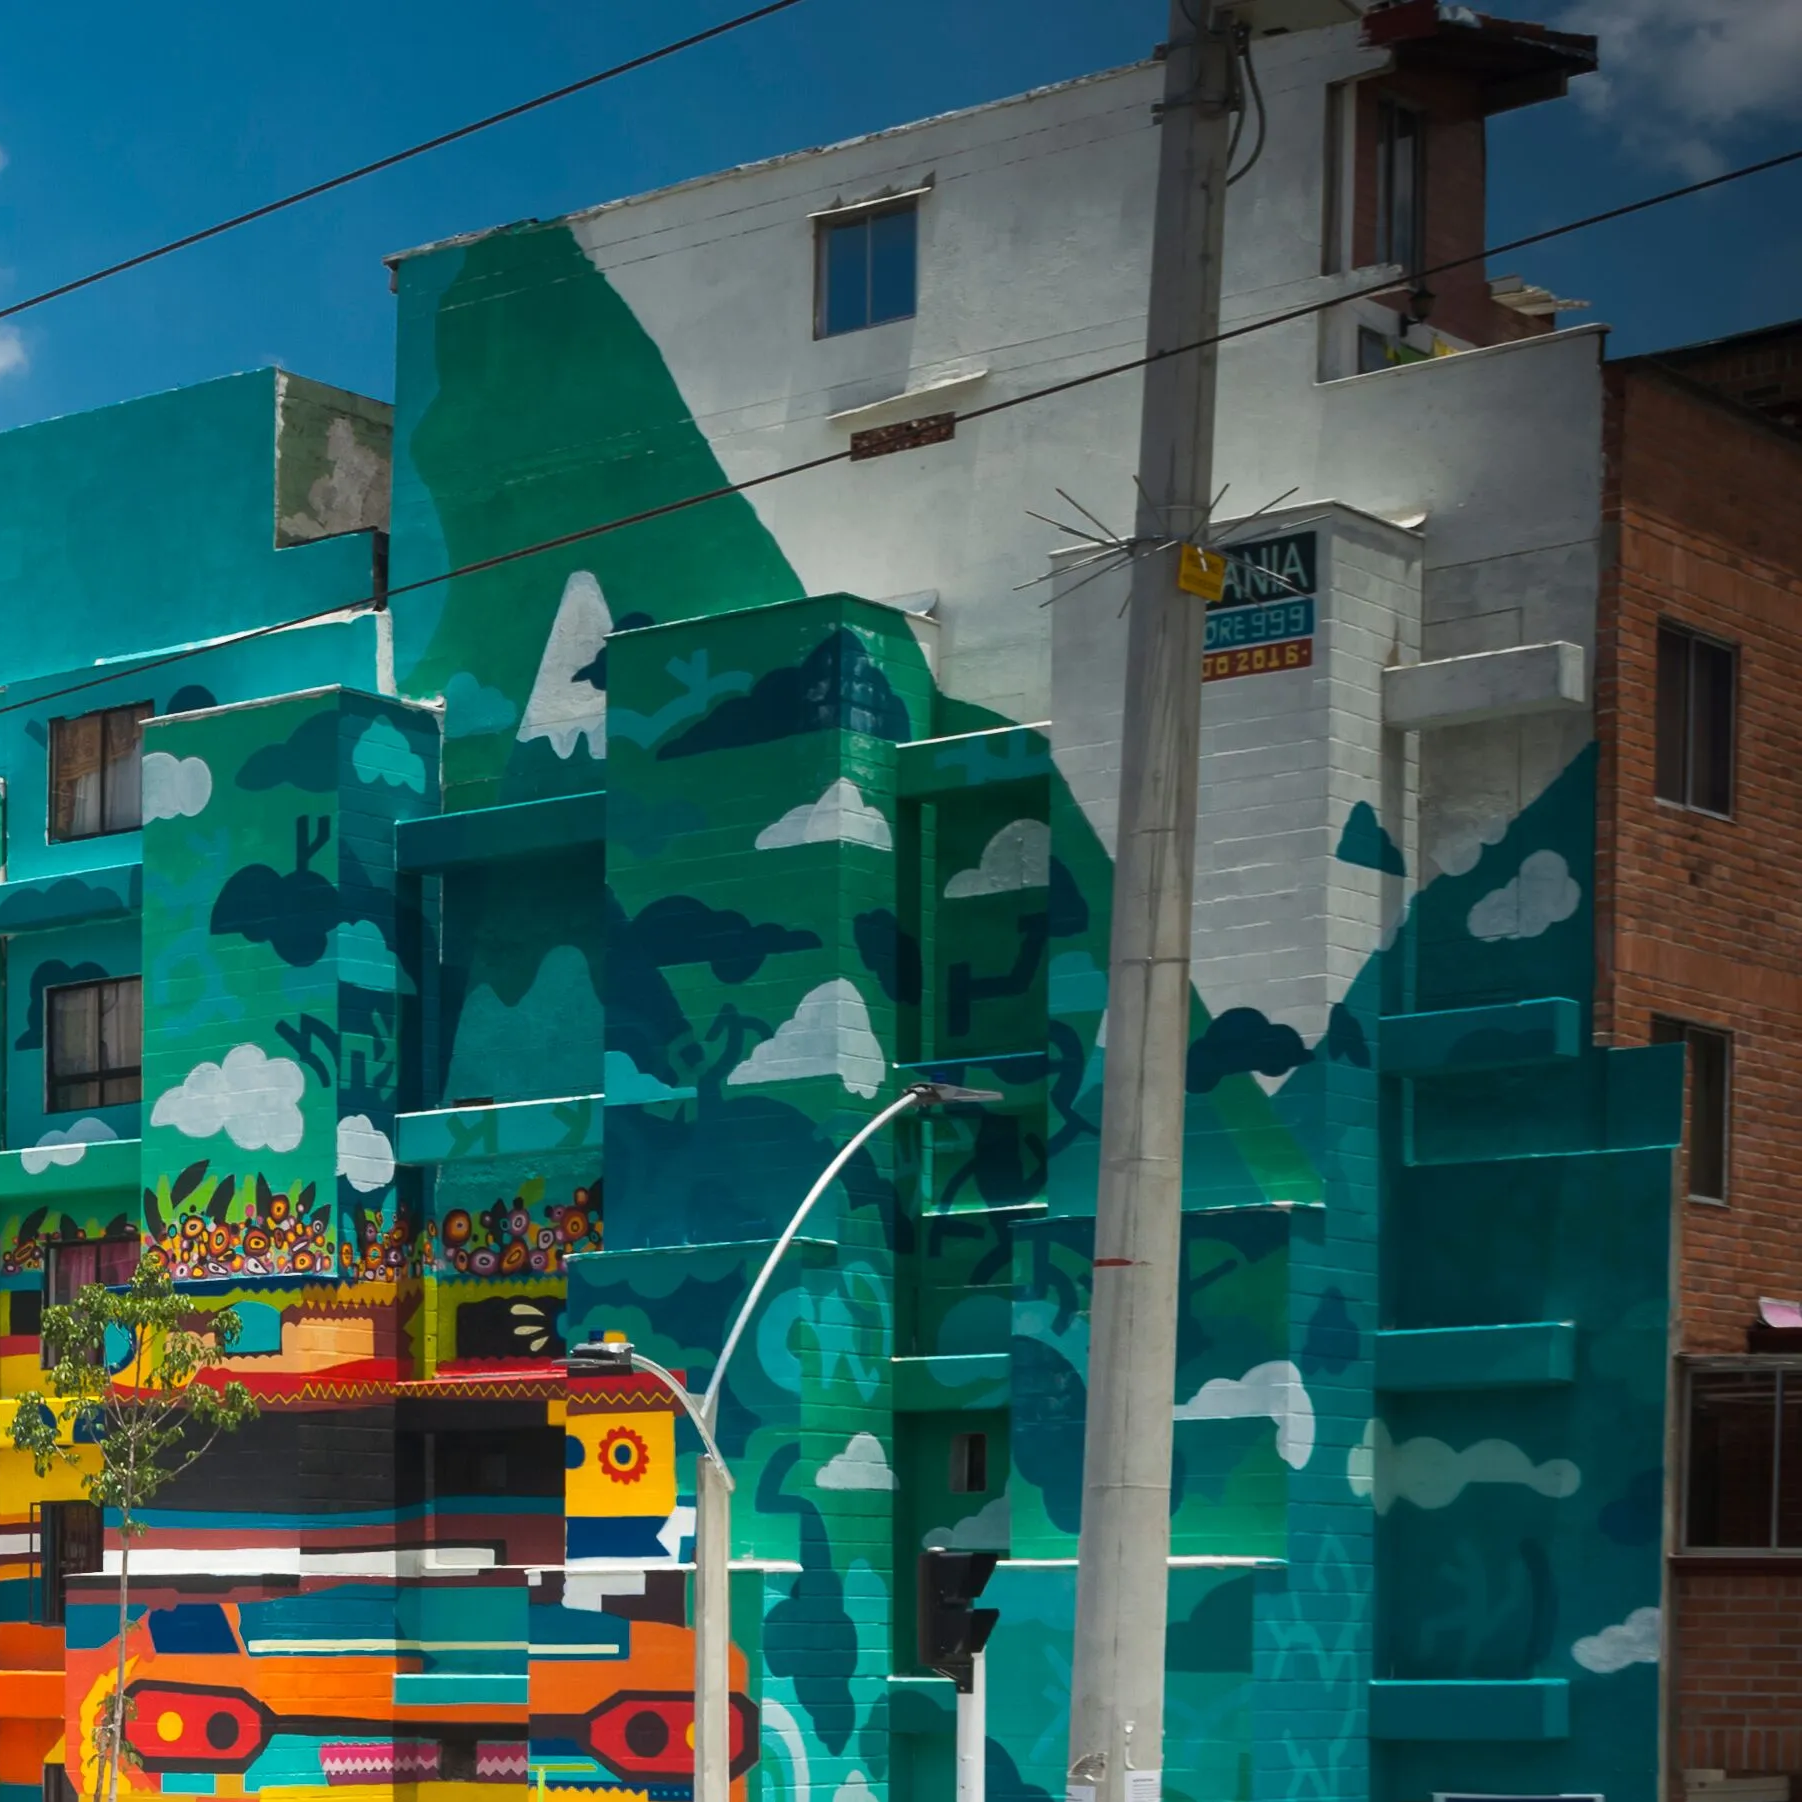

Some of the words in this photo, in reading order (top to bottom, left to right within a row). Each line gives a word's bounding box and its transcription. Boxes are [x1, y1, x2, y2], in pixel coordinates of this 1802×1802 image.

[1221, 542, 1309, 600] ANIA
[1251, 605, 1306, 638] 999
[1236, 644, 1300, 672] 2016
